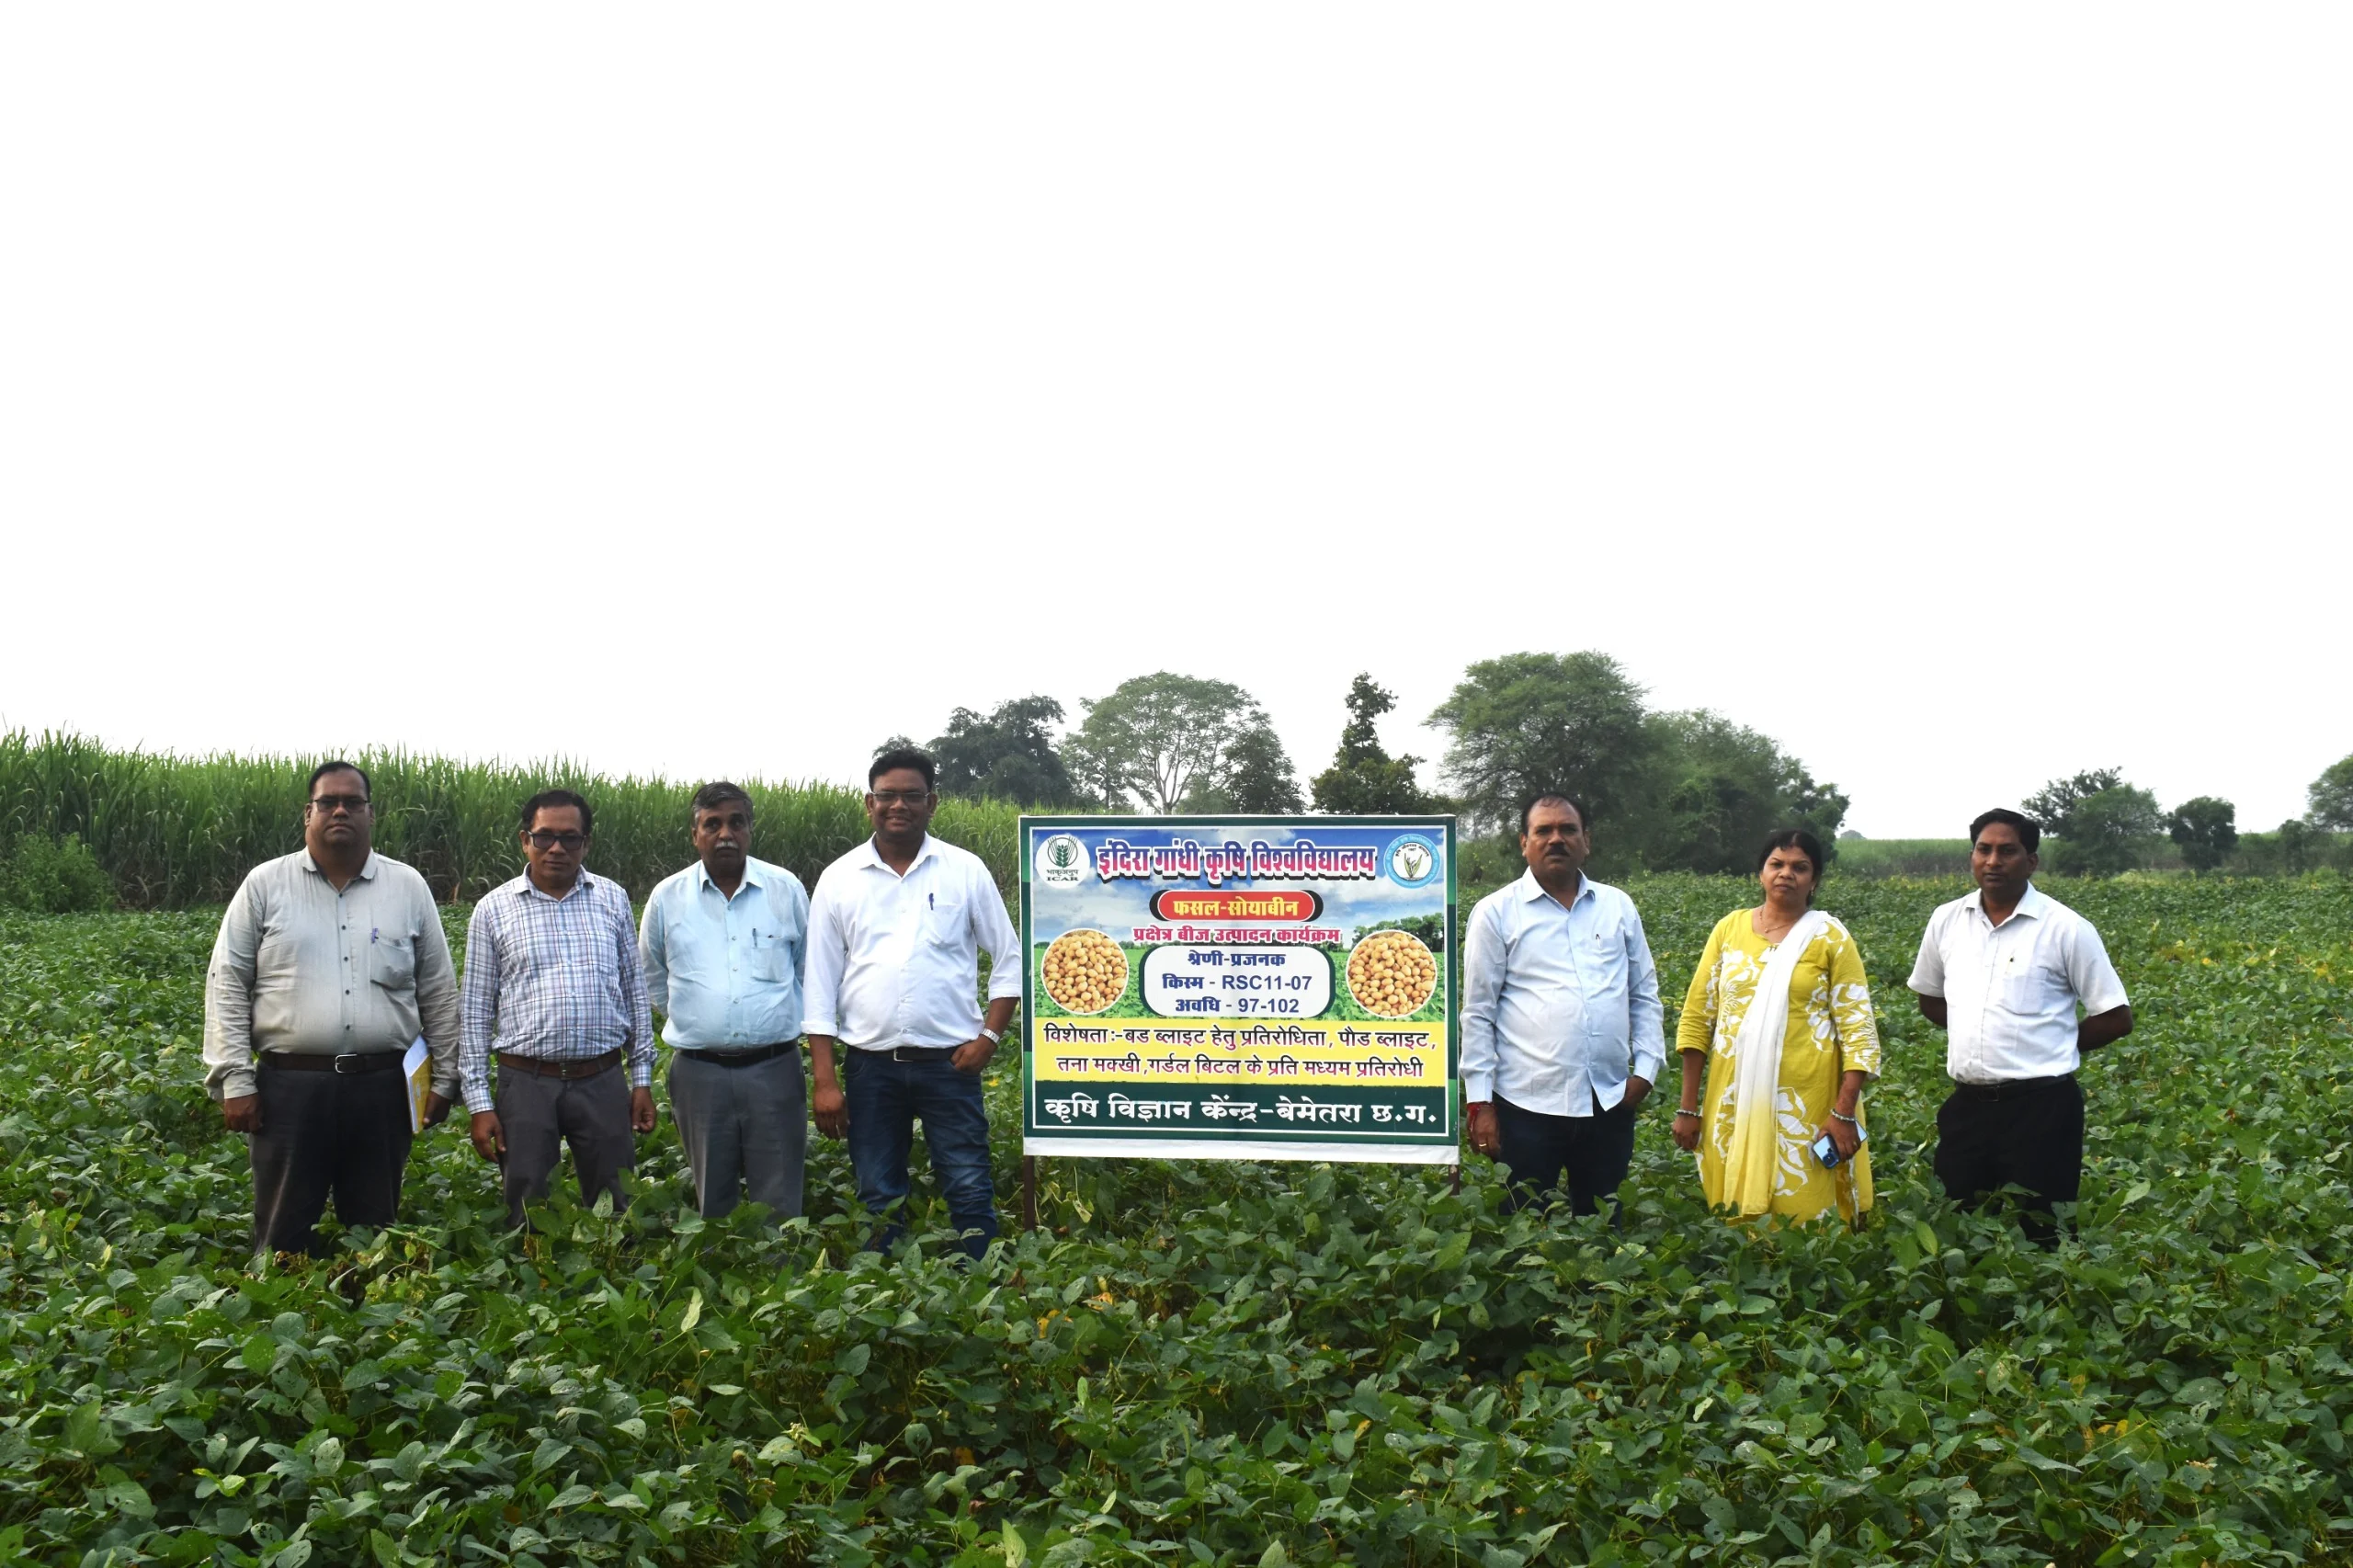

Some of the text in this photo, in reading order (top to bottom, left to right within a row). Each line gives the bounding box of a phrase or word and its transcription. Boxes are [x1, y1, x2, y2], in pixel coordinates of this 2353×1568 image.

[1097, 838, 1151, 878] इंदिरा
[1153, 838, 1201, 877] गांधी
[1203, 840, 1247, 883] कृषि
[1250, 839, 1377, 877] विश्वविद्यालय
[1173, 895, 1299, 916] फसल-सोयाबीन
[1133, 925, 1341, 942] प्रक्षेत्र बीज उत्पादन कार्यक्रम
[1187, 949, 1287, 967] श्रेणी-प्रजनक
[1161, 973, 1205, 990] किस्म
[1222, 974, 1313, 991] RSC11-07
[1175, 995, 1222, 1013] अवधि
[1237, 998, 1300, 1013] 97-102
[1154, 1028, 1207, 1047] ब्लाइट
[1211, 1024, 1236, 1051] हेतु
[1337, 1026, 1370, 1047] पौड
[1056, 1057, 1089, 1073] तना
[1194, 1053, 1241, 1074] बिटल
[1245, 1054, 1264, 1074] के
[1267, 1054, 1299, 1076] प्रति
[1302, 1061, 1351, 1076] मध्यम
[1355, 1056, 1424, 1078] प्रतिरोधी
[1043, 1091, 1099, 1124] कृषि
[1108, 1092, 1192, 1122] विज्ञान
[1370, 1104, 1438, 1124] छ.ग.
